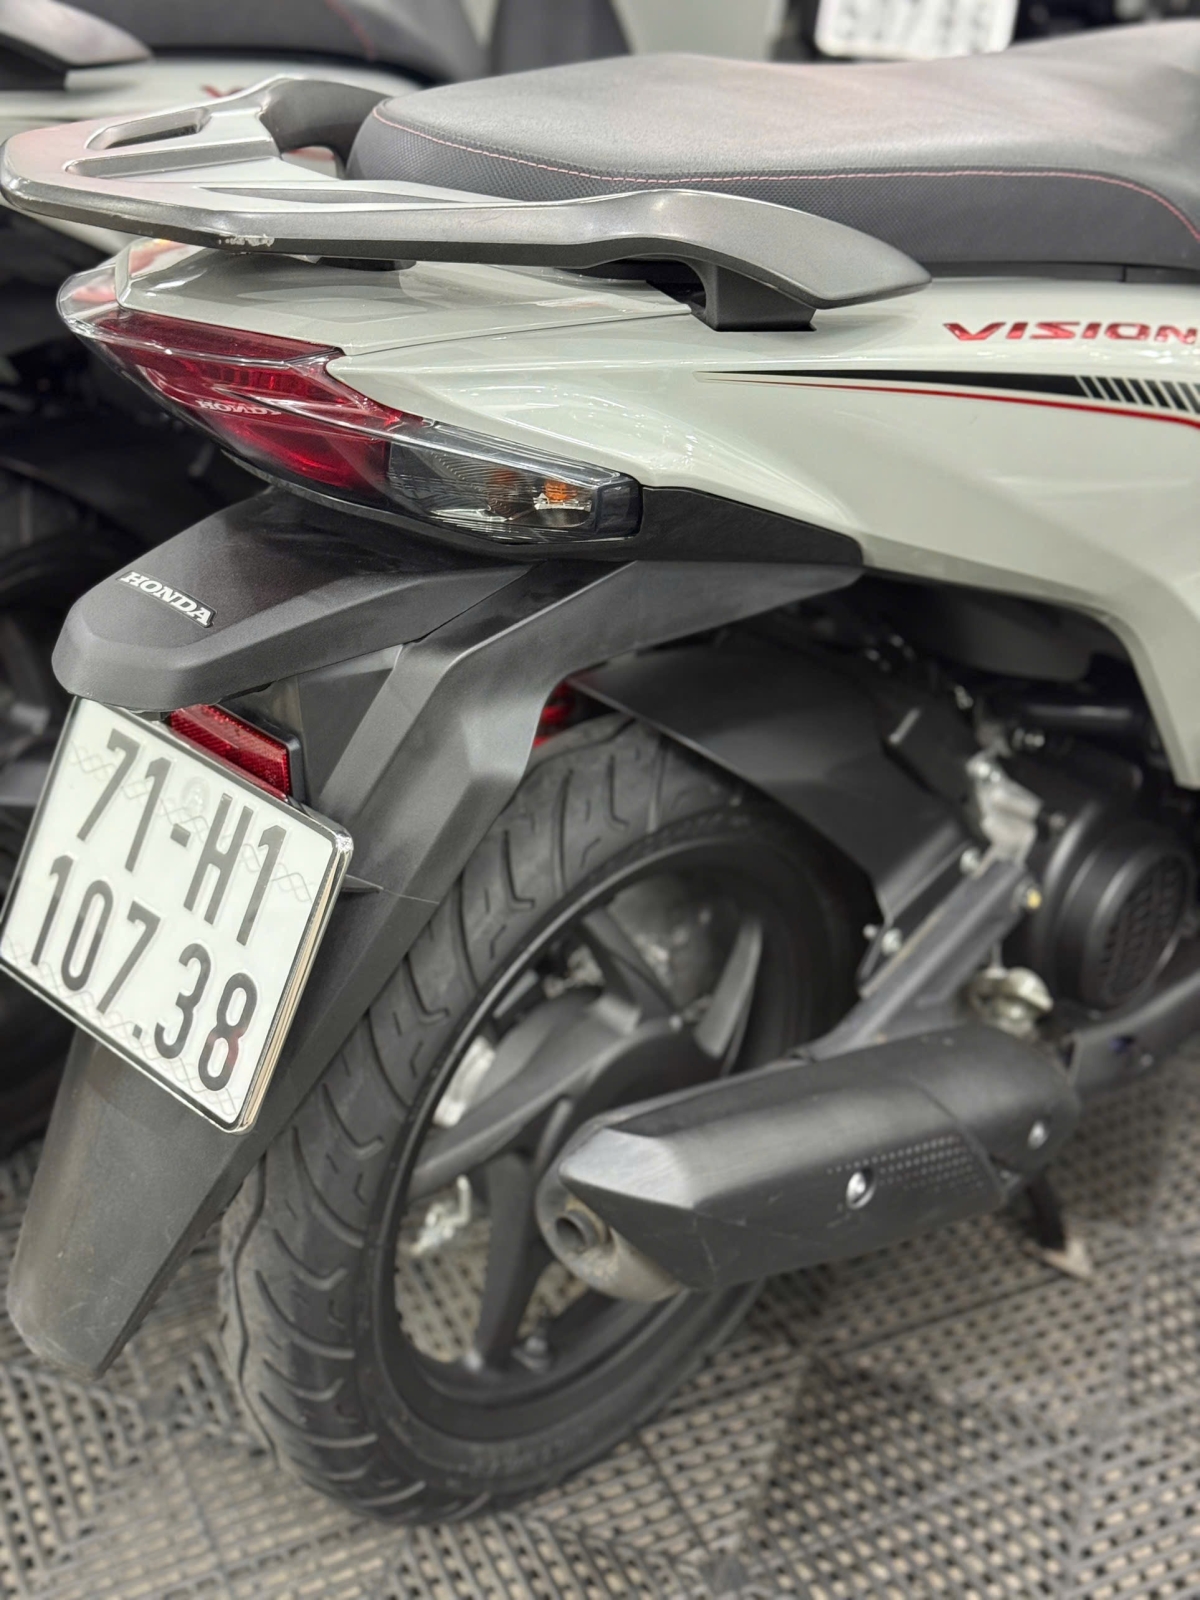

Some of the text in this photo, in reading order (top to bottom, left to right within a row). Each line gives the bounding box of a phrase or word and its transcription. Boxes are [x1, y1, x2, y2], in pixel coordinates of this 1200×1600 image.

[943, 321, 1198, 345] VISION
[120, 571, 211, 626] HONDA
[77, 728, 287, 947] 71-H1
[31, 854, 258, 1092] 107.38
